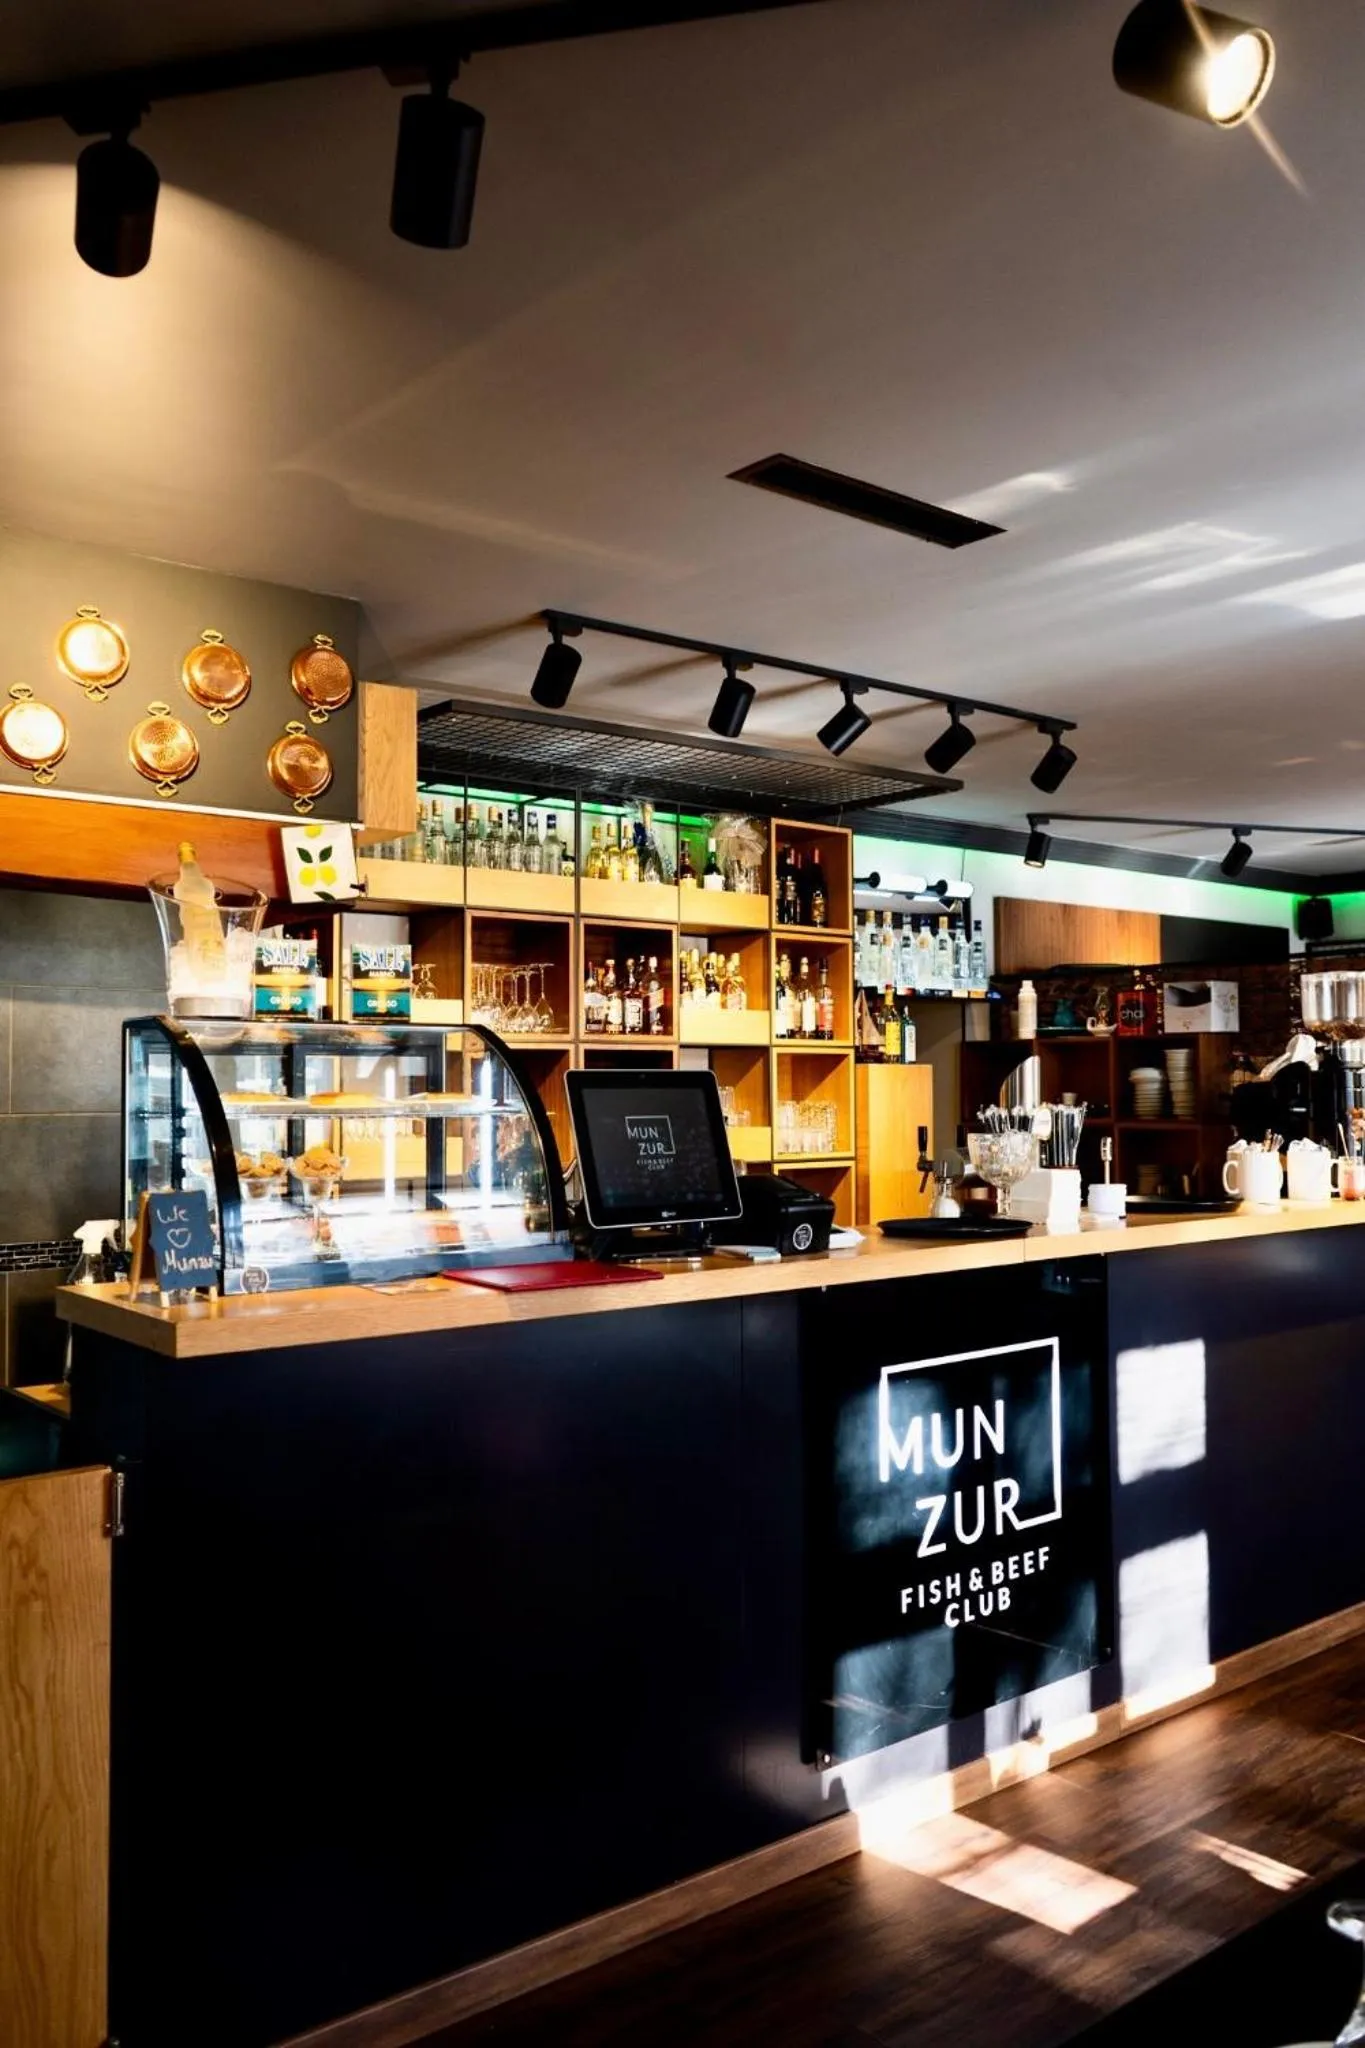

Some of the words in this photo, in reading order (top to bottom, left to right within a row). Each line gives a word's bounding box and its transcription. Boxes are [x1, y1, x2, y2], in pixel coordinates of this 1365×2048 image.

[627, 1126, 659, 1140] MUN
[638, 1142, 665, 1155] ZUR
[156, 1205, 189, 1223] We
[879, 1399, 1005, 1482] MUN
[916, 1477, 1023, 1557] ZUR
[901, 1573, 961, 1614] FISH
[969, 1567, 984, 1591] &
[991, 1546, 1050, 1585] BEEF
[944, 1587, 1011, 1628] CLUB
